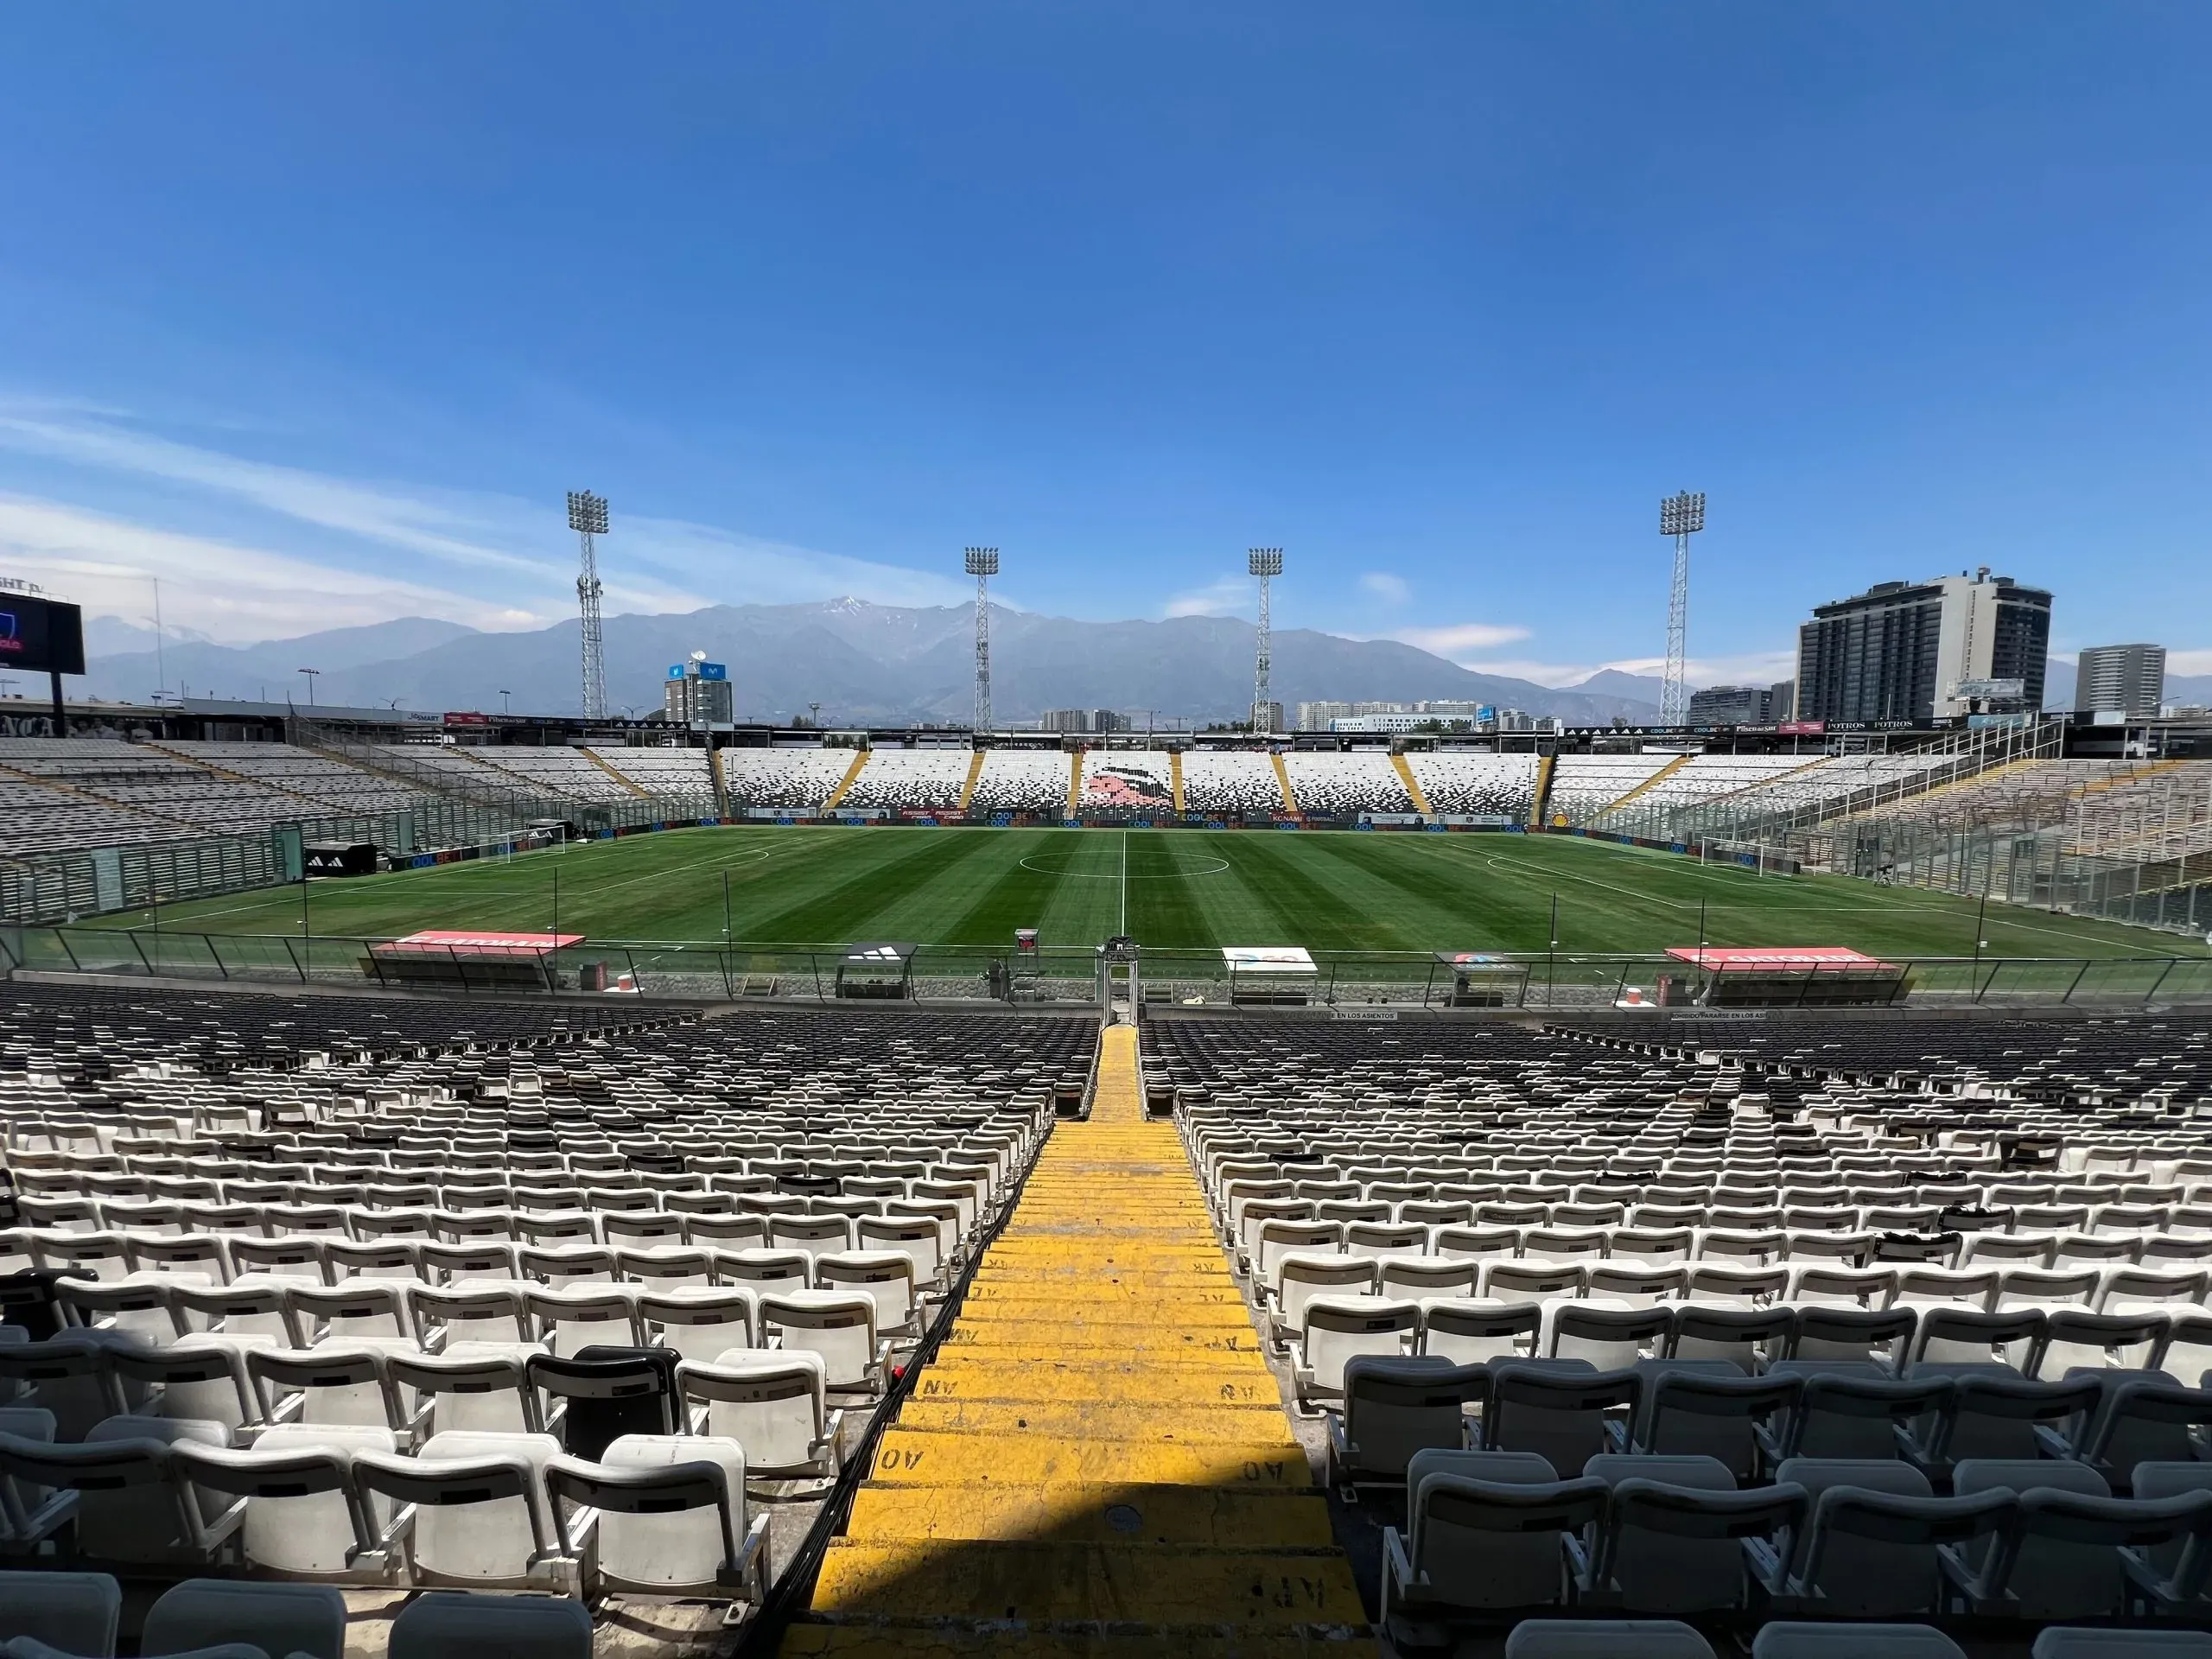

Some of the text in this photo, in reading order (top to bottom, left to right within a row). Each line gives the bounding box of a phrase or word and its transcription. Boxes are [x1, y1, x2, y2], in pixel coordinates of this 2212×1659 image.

[990, 811, 1033, 820] COOLBET
[881, 1448, 925, 1470] AO
[1243, 1460, 1284, 1482] AO
